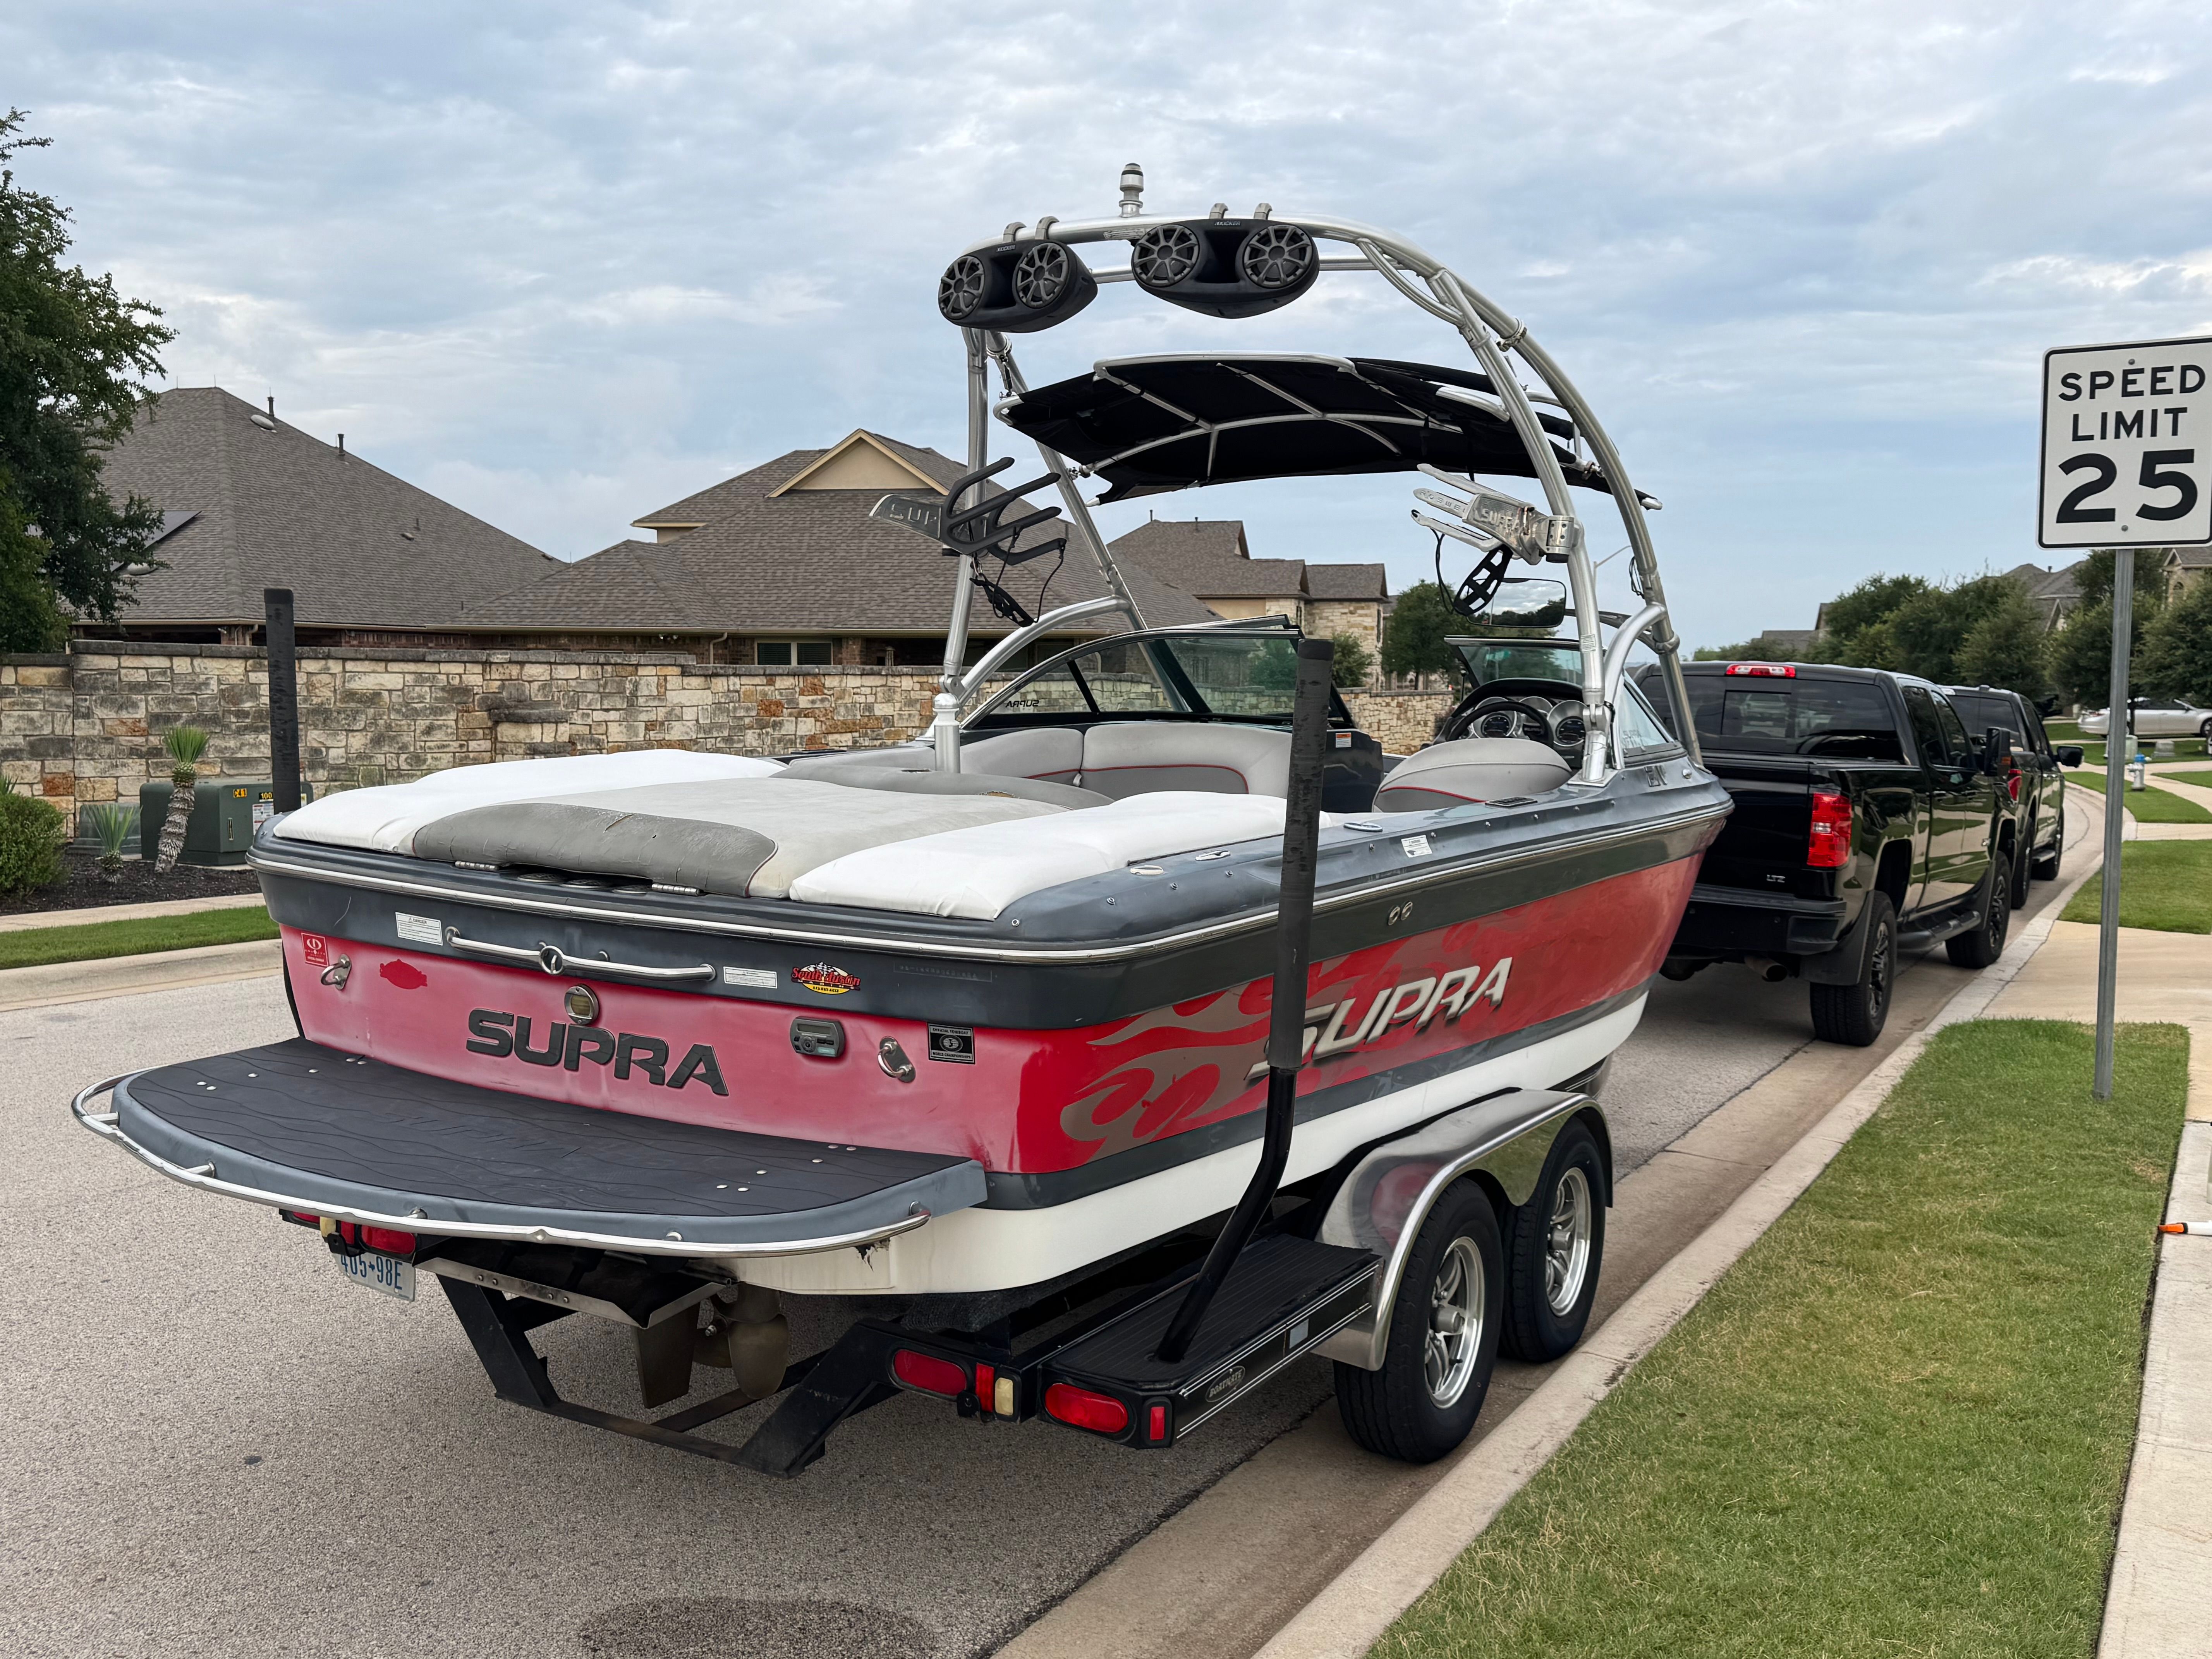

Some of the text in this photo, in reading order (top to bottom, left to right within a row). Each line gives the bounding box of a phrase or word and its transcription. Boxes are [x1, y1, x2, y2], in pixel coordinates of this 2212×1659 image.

[2058, 364, 2206, 402] SPEED
[2071, 407, 2188, 441] LIMIT
[2056, 448, 2198, 524] 25
[1766, 874, 1786, 883] LTZ
[792, 967, 822, 981] South
[466, 1007, 729, 1096] SUPRA
